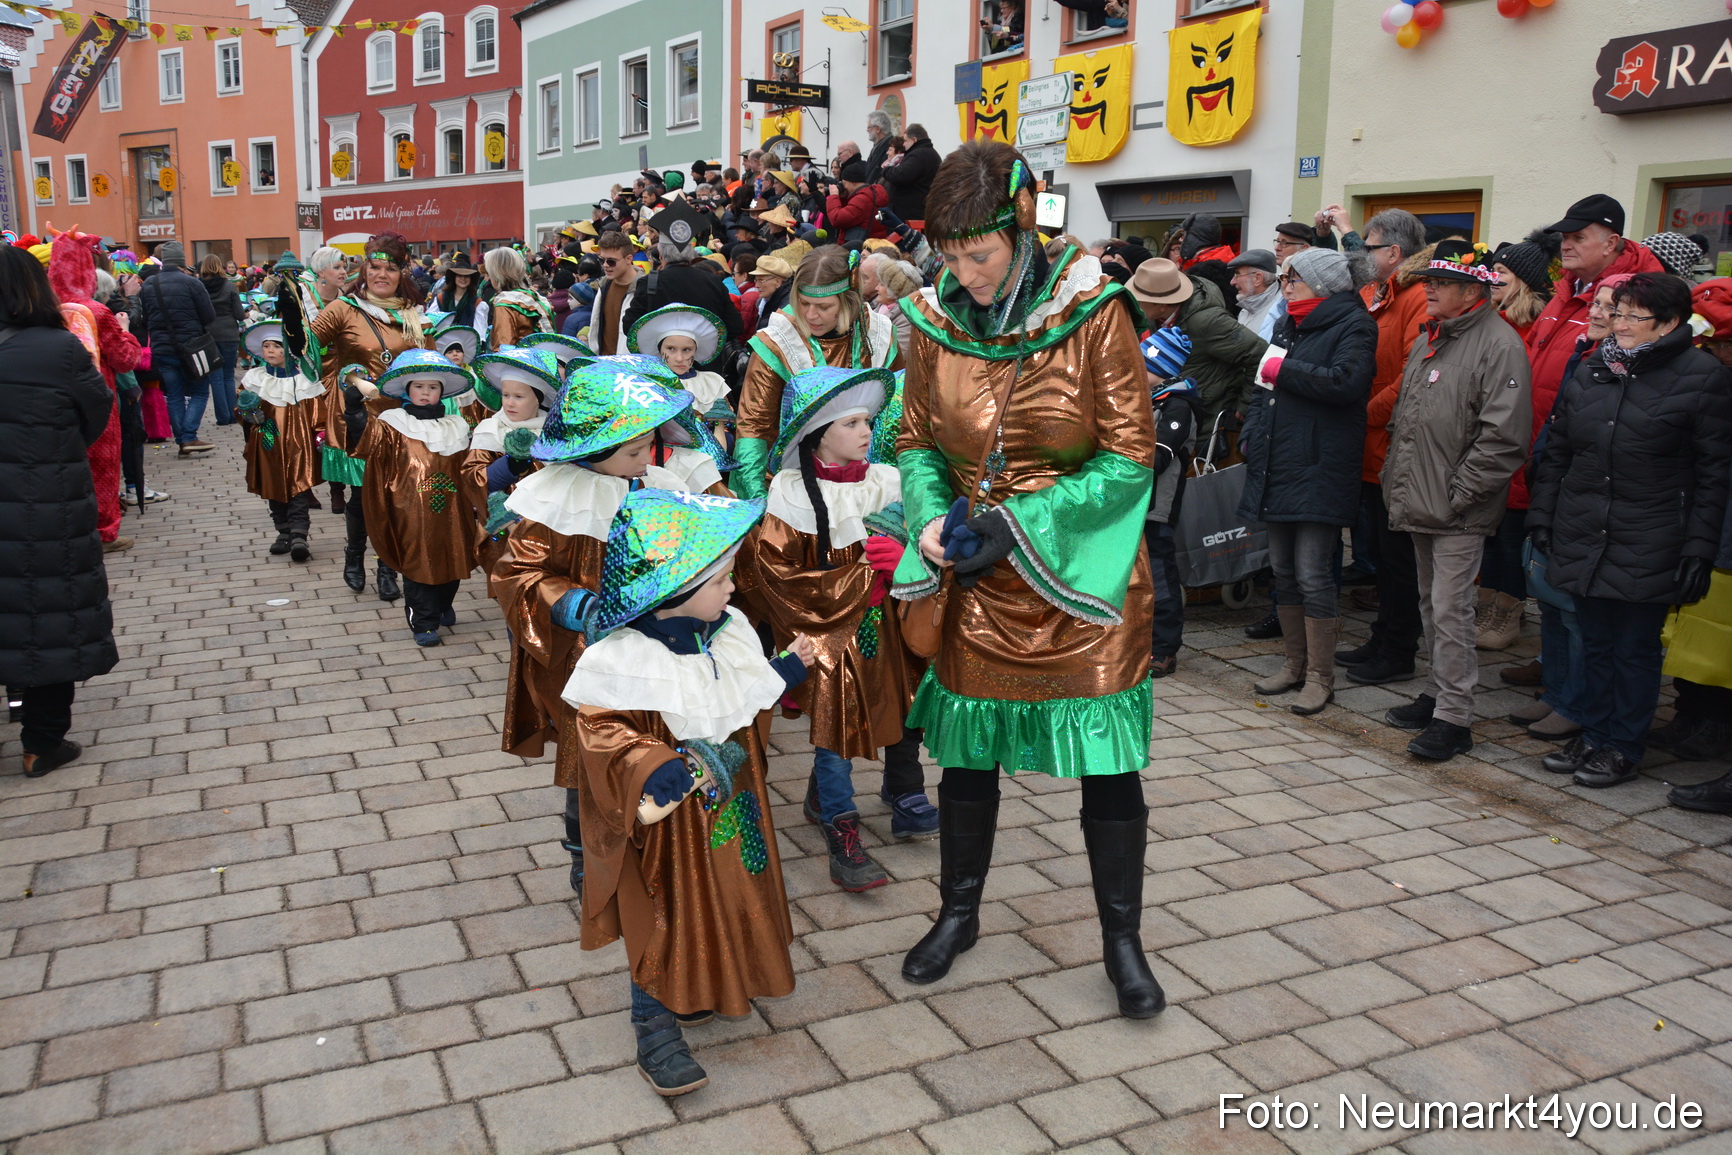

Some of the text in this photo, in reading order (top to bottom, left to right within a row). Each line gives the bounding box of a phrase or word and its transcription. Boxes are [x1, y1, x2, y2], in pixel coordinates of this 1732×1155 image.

[756, 83, 822, 98] RÖHLICH
[1301, 158, 1316, 169] 20
[1158, 188, 1217, 206] UHREN
[299, 206, 319, 216] CAFÉ
[416, 199, 441, 217] Erlebnis
[138, 223, 176, 237] GÖTZ
